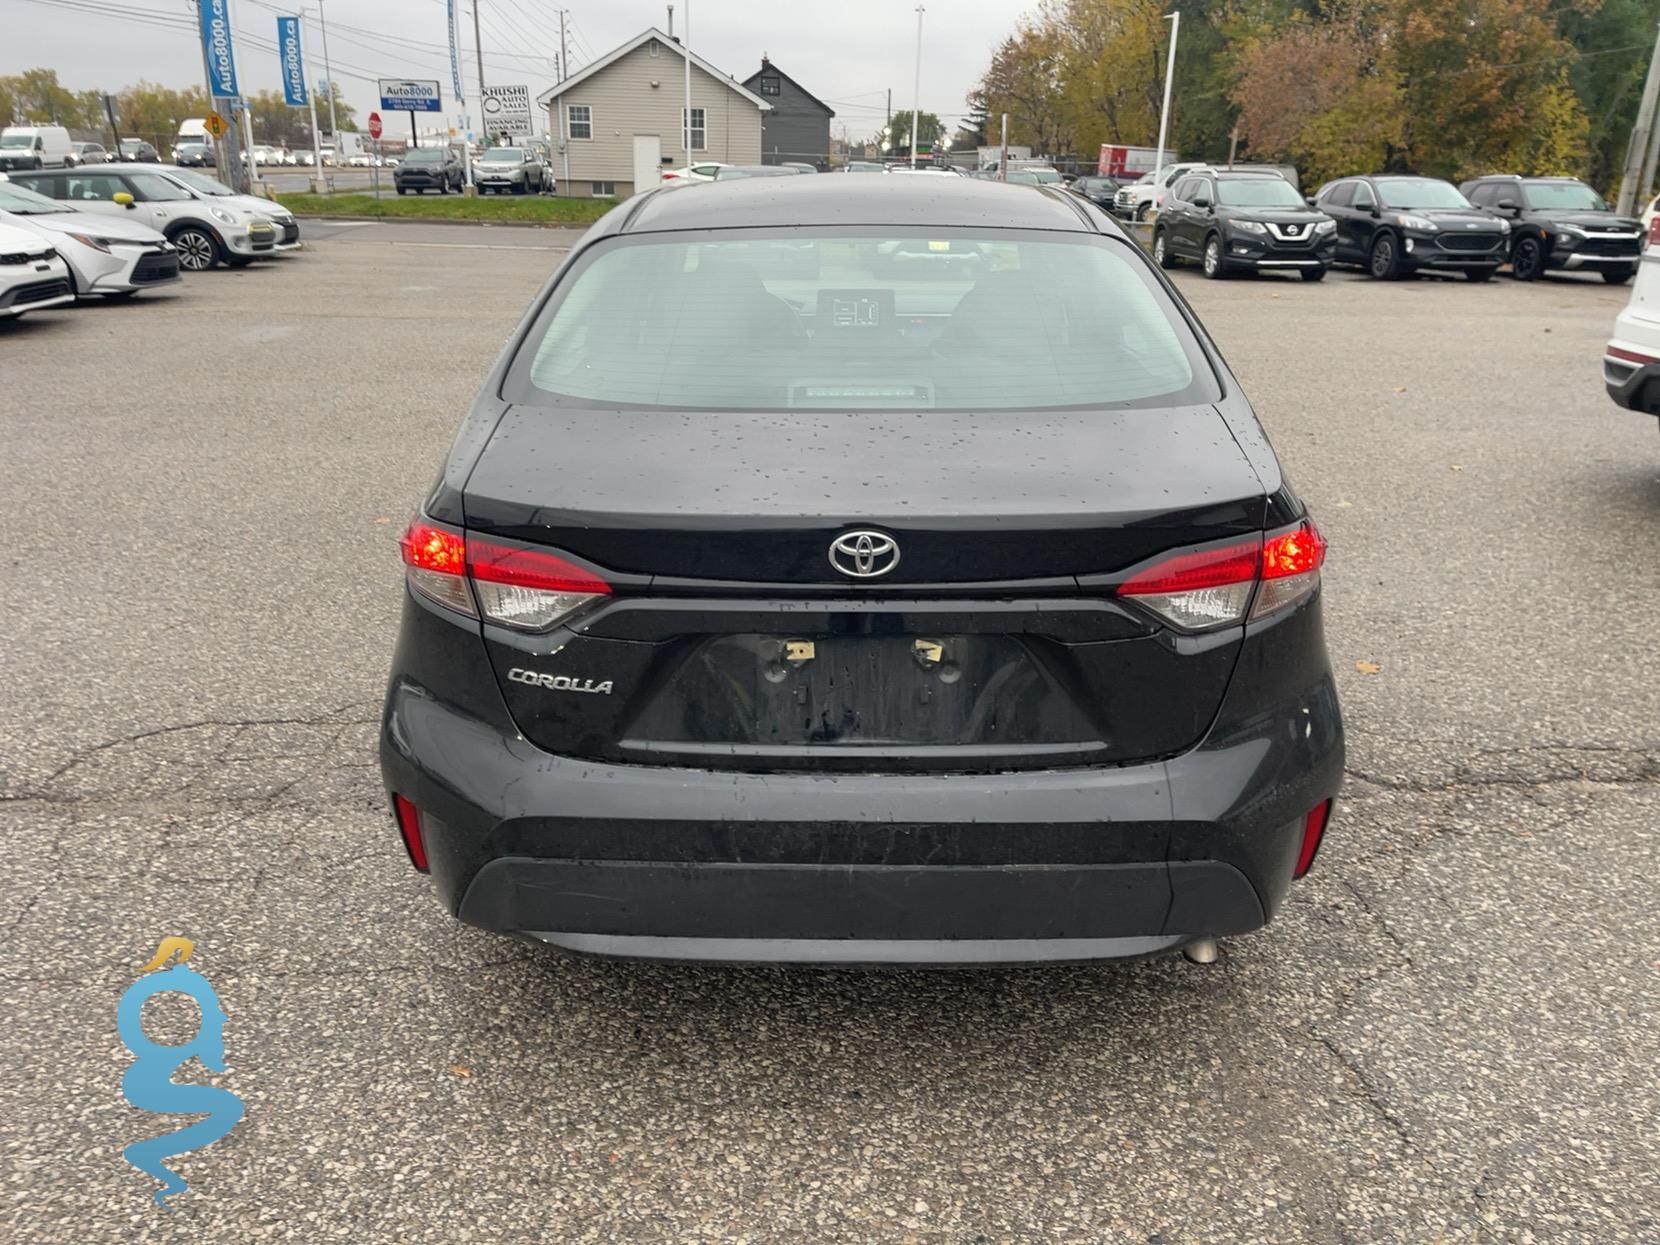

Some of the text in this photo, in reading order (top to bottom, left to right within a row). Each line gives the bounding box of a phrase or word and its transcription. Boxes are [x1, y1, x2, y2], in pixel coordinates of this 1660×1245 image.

[212, 0, 234, 93] Auto8000.ca
[285, 20, 304, 103] Auto8000.ca
[386, 86, 433, 96] Auto8000
[481, 87, 525, 97] KHUSHI
[507, 668, 613, 694] COROLLA
